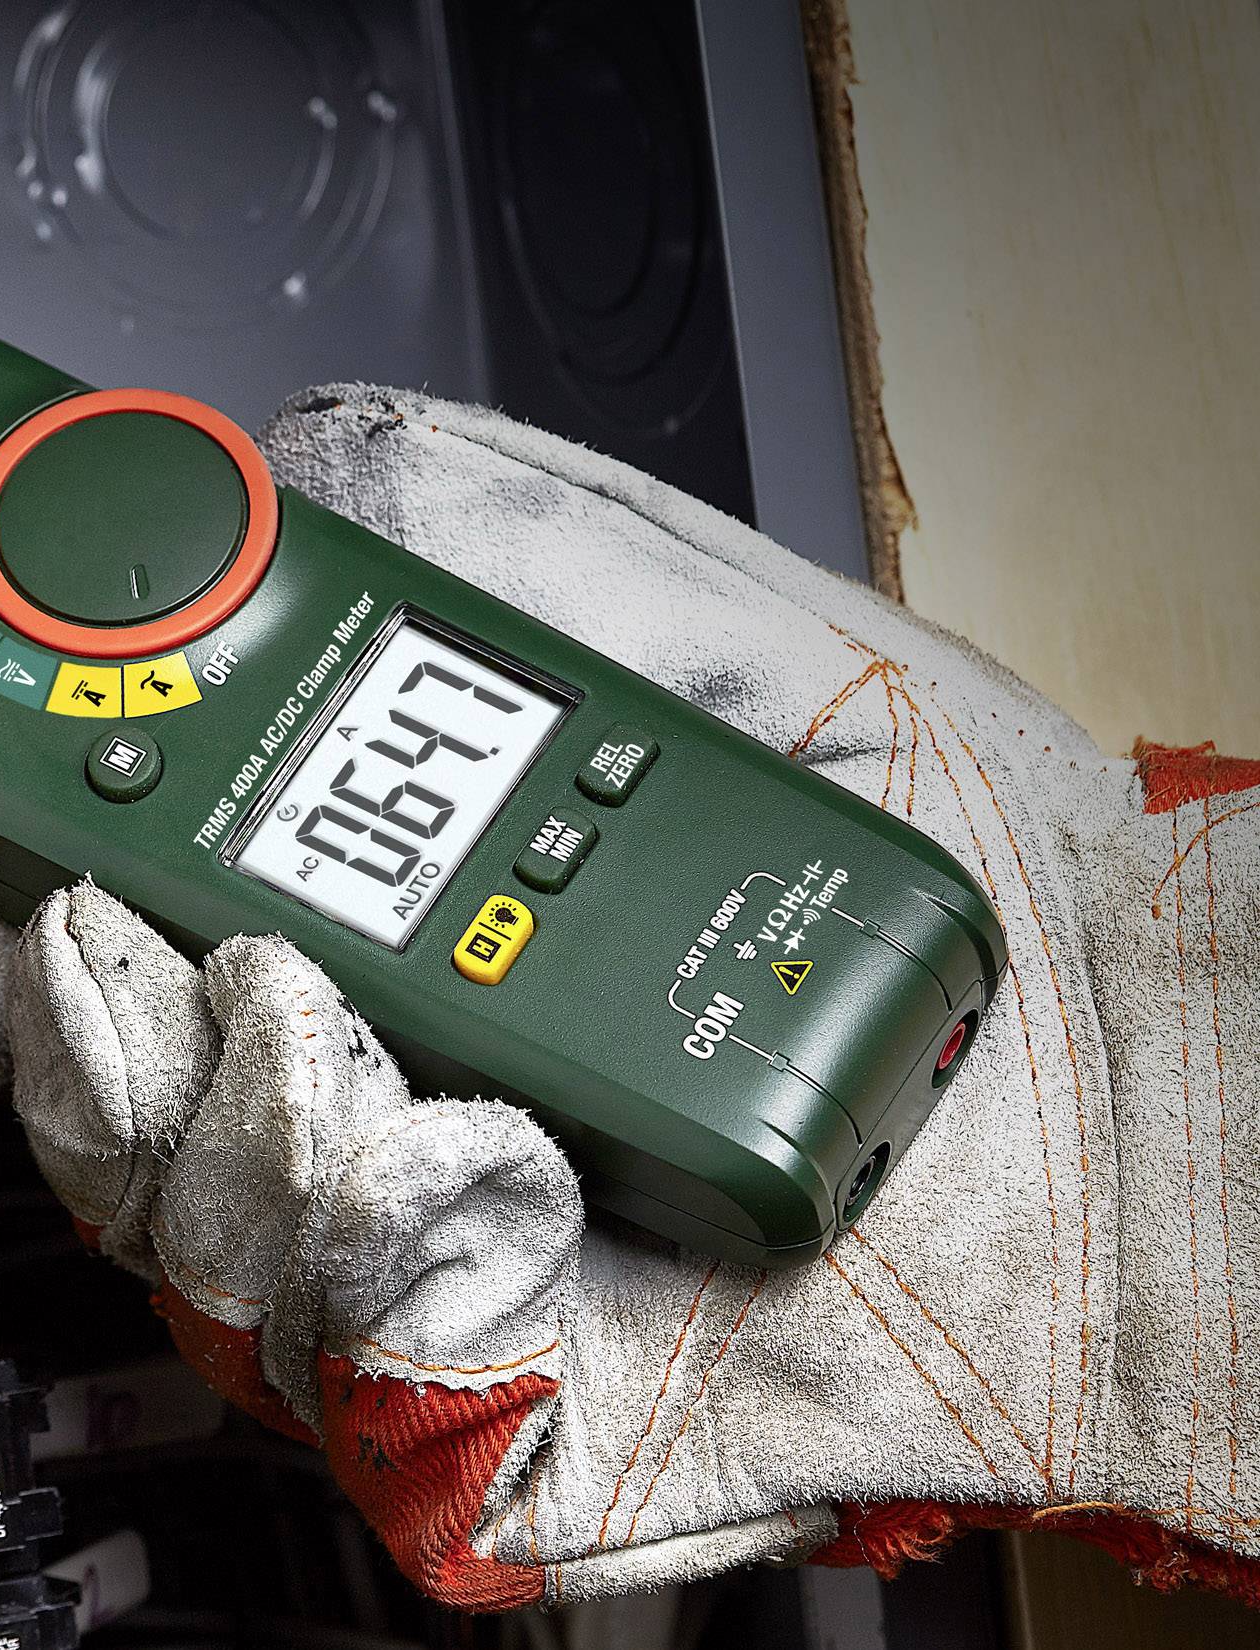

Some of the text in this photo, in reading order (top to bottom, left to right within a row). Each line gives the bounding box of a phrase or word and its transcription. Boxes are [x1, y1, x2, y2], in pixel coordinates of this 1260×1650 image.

[201, 641, 240, 687] OFF
[193, 591, 375, 851] TRMS 400A AC/DC Clamp Meter
[336, 726, 360, 742] A
[107, 743, 139, 771] M
[590, 742, 624, 773] REL
[605, 743, 645, 789] ZERO
[529, 815, 567, 855] MAX
[548, 828, 584, 863] MIN
[295, 856, 320, 882] AC
[809, 867, 849, 909] Temp
[392, 862, 441, 921] AUTO
[472, 938, 495, 957] H
[676, 888, 748, 979] CAT III 600V
[683, 991, 745, 1061] COM
